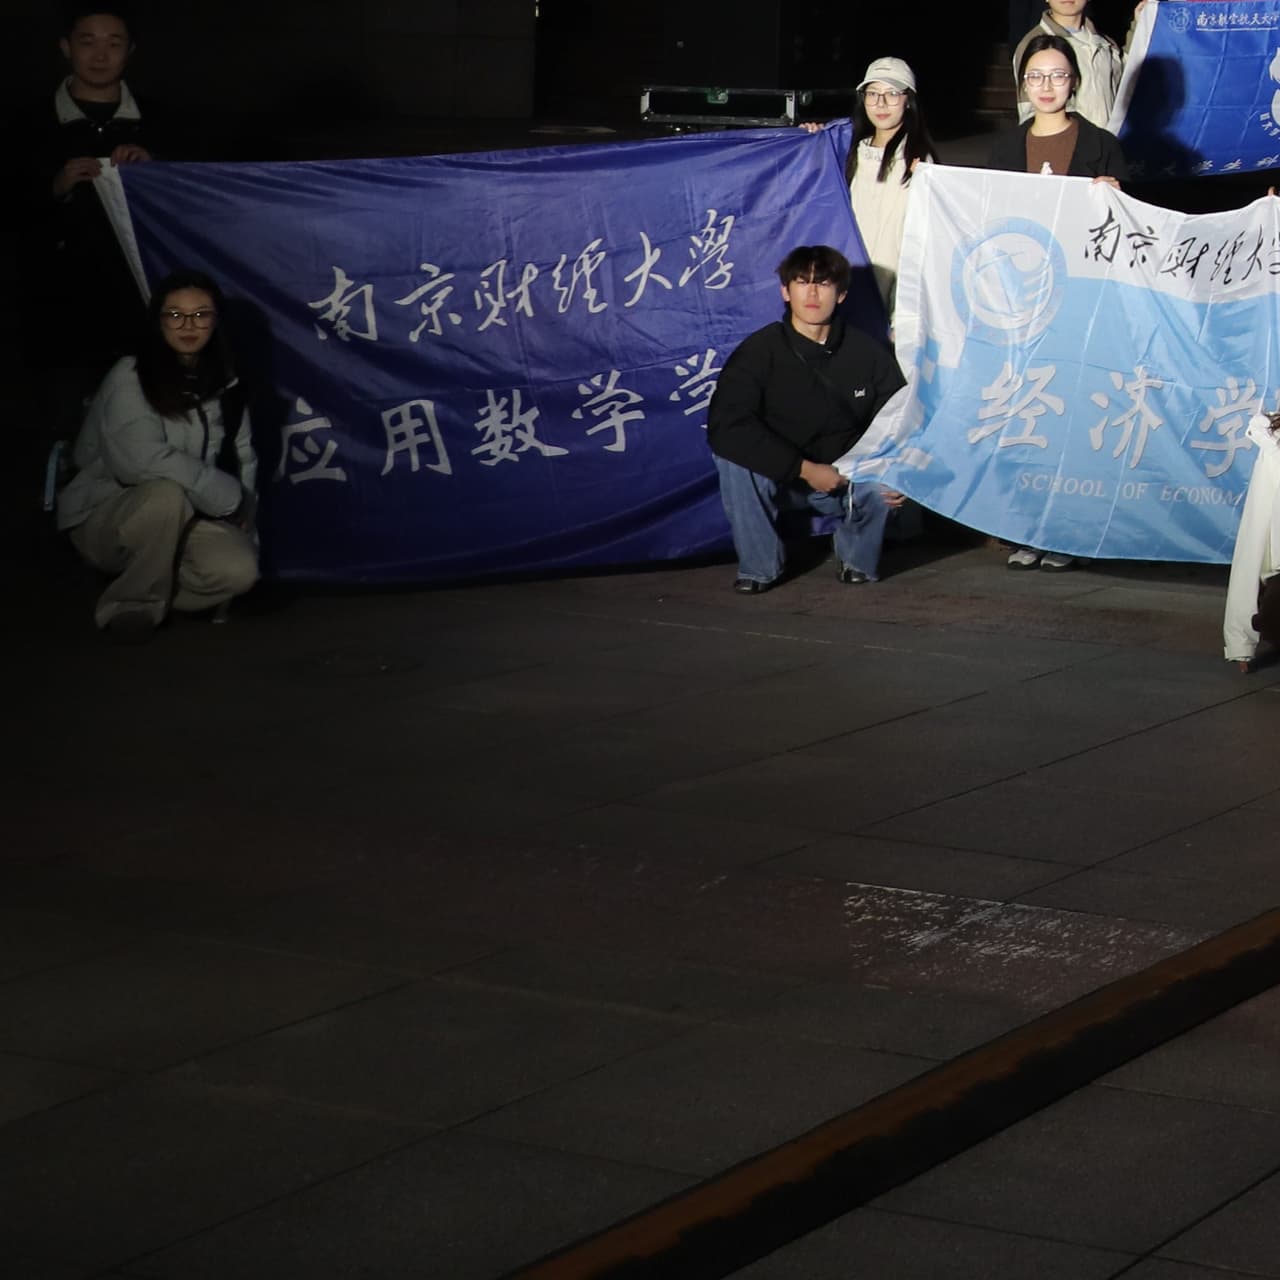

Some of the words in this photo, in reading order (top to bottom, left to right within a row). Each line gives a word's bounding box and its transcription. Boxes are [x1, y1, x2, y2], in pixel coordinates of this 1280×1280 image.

[1020, 472, 1106, 498] SCHOOL
[1122, 482, 1149, 501] OF
[1160, 485, 1243, 507] ECONOM
